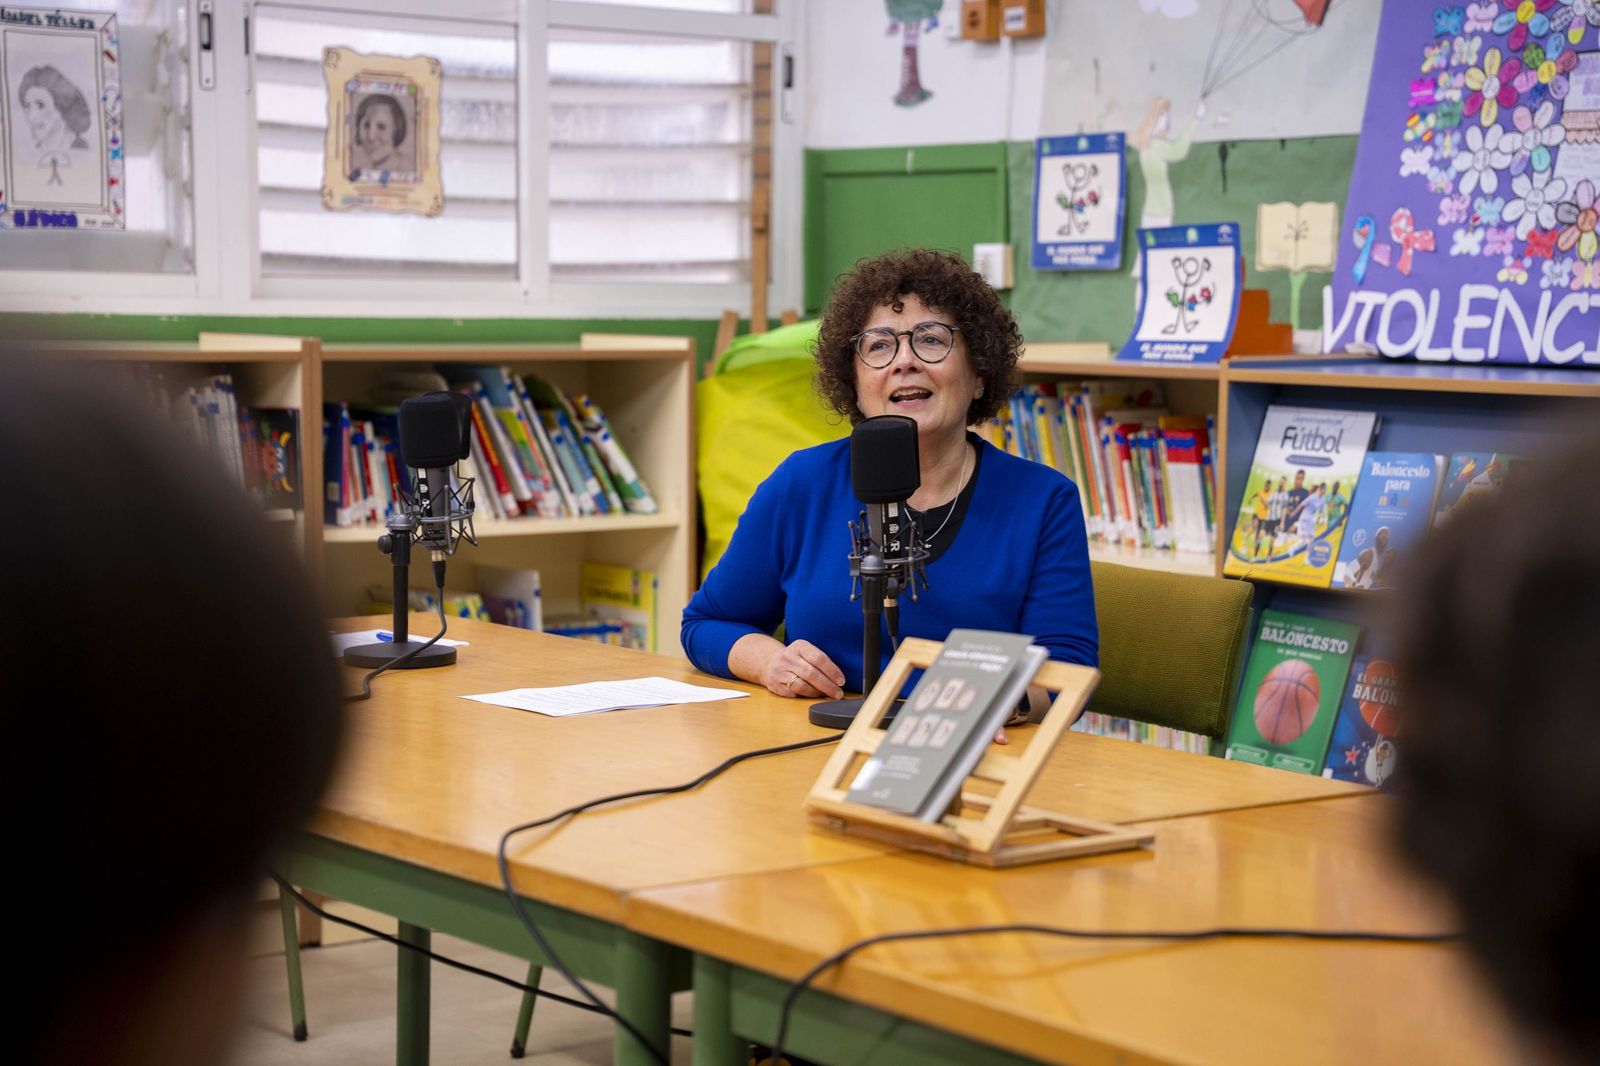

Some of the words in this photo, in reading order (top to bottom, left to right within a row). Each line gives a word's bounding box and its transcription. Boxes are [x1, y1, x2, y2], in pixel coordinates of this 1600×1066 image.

[1280, 425, 1344, 455] Fútbol
[1371, 461, 1430, 478] Baloncesto
[1384, 479, 1411, 494] para
[1260, 627, 1349, 655] BALONCESTO
